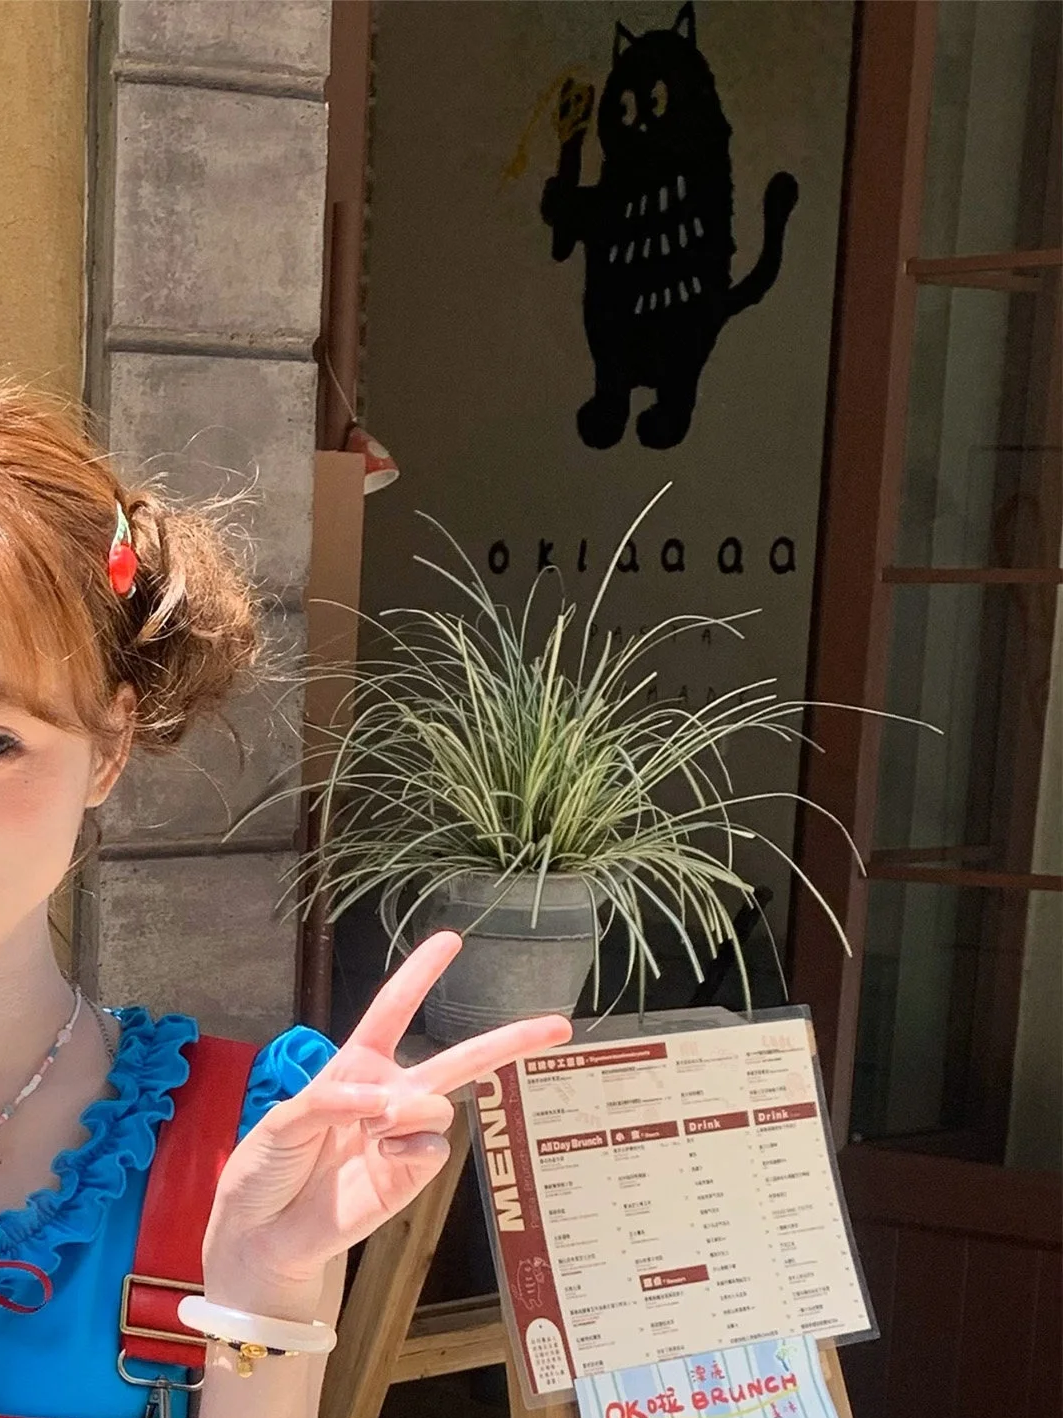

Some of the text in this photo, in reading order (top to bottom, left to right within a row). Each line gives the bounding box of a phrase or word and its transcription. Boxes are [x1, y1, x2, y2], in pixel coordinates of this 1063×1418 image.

[758, 1109, 789, 1123] Drink
[689, 1119, 722, 1132] Drink
[476, 1069, 526, 1232] MENU
[540, 1135, 603, 1153] All Day Brunch
[691, 1373, 798, 1411] BRUNCH
